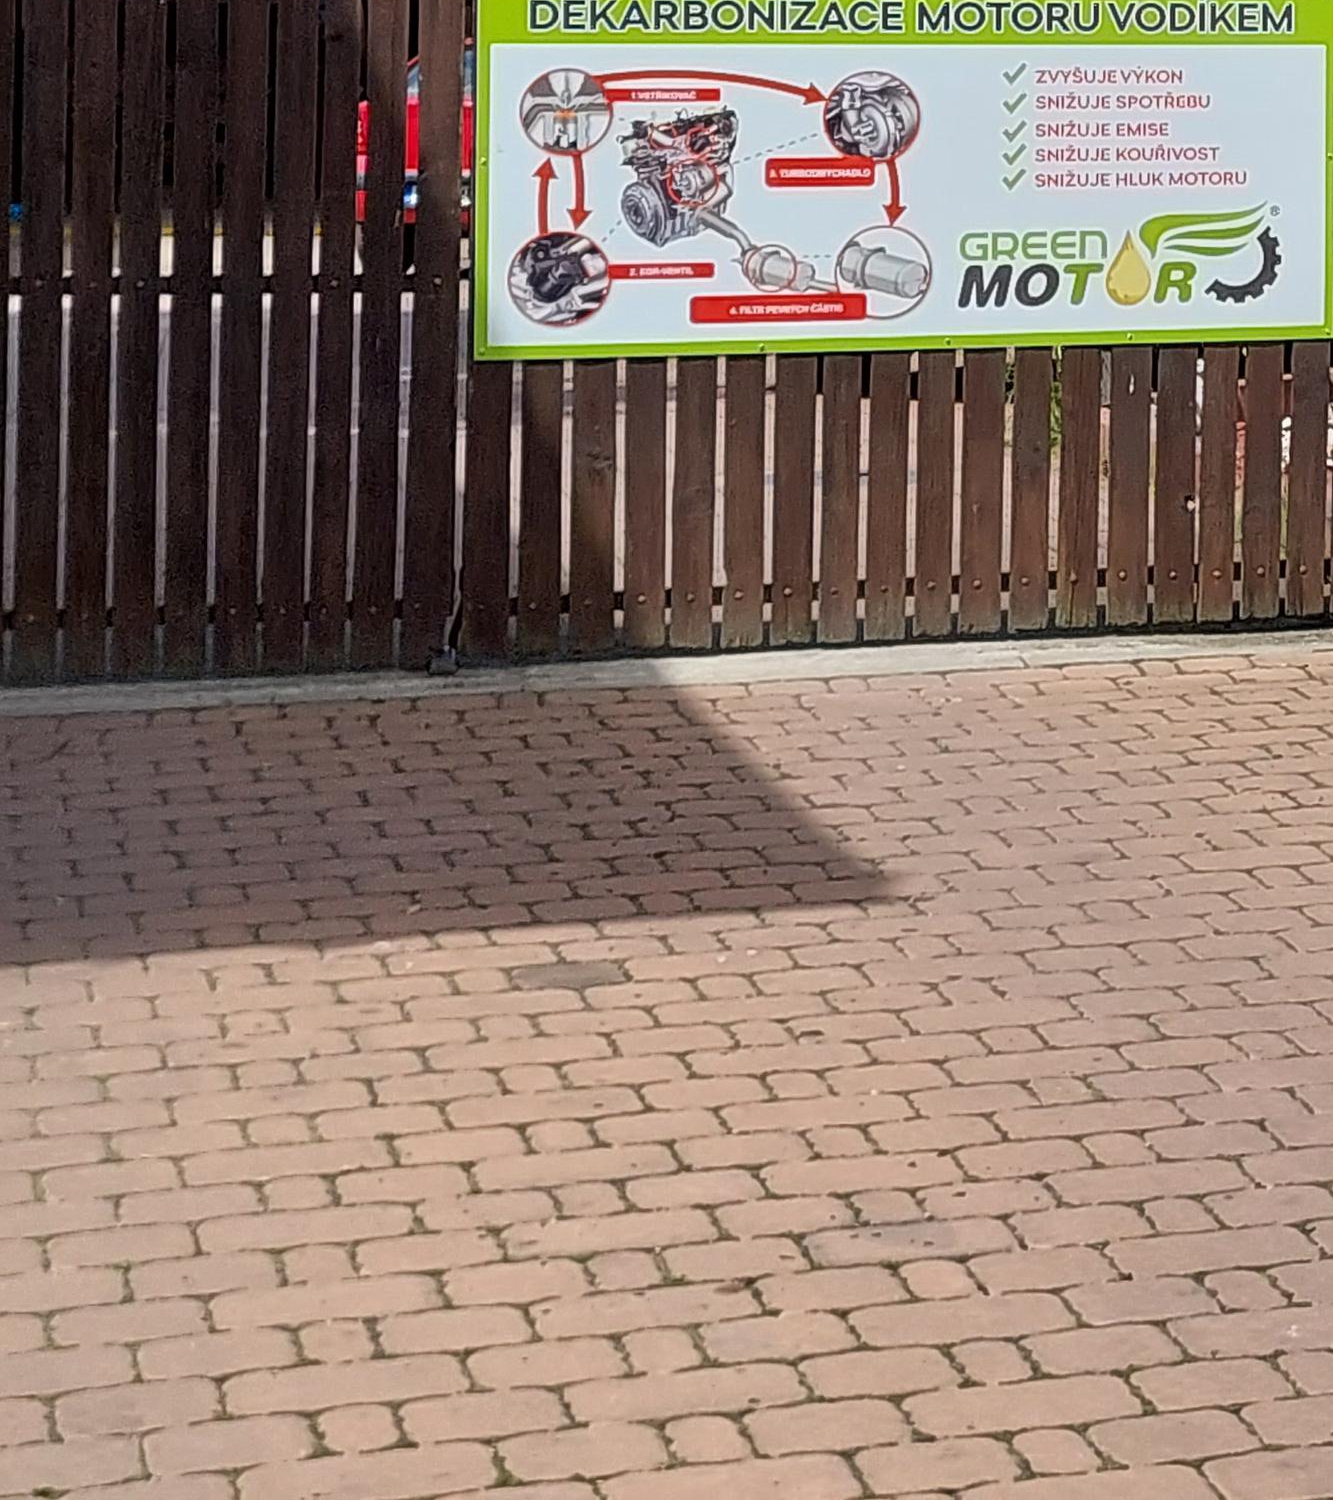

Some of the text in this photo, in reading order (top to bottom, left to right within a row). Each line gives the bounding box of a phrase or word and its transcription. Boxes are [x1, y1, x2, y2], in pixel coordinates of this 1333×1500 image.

[917, 1, 1099, 32] MOTORU
[1034, 66, 1184, 84] ZVYŠUJE VÝKON
[1034, 91, 1112, 110] SNIŽUJE
[1034, 120, 1170, 138] SNIŽUJE EMISE
[1034, 143, 1221, 163] SNIŽUJE KOUŘIVOST
[1034, 169, 1248, 188] SNIŽUJE HLUK MOTORU
[958, 230, 1109, 261] GREEN
